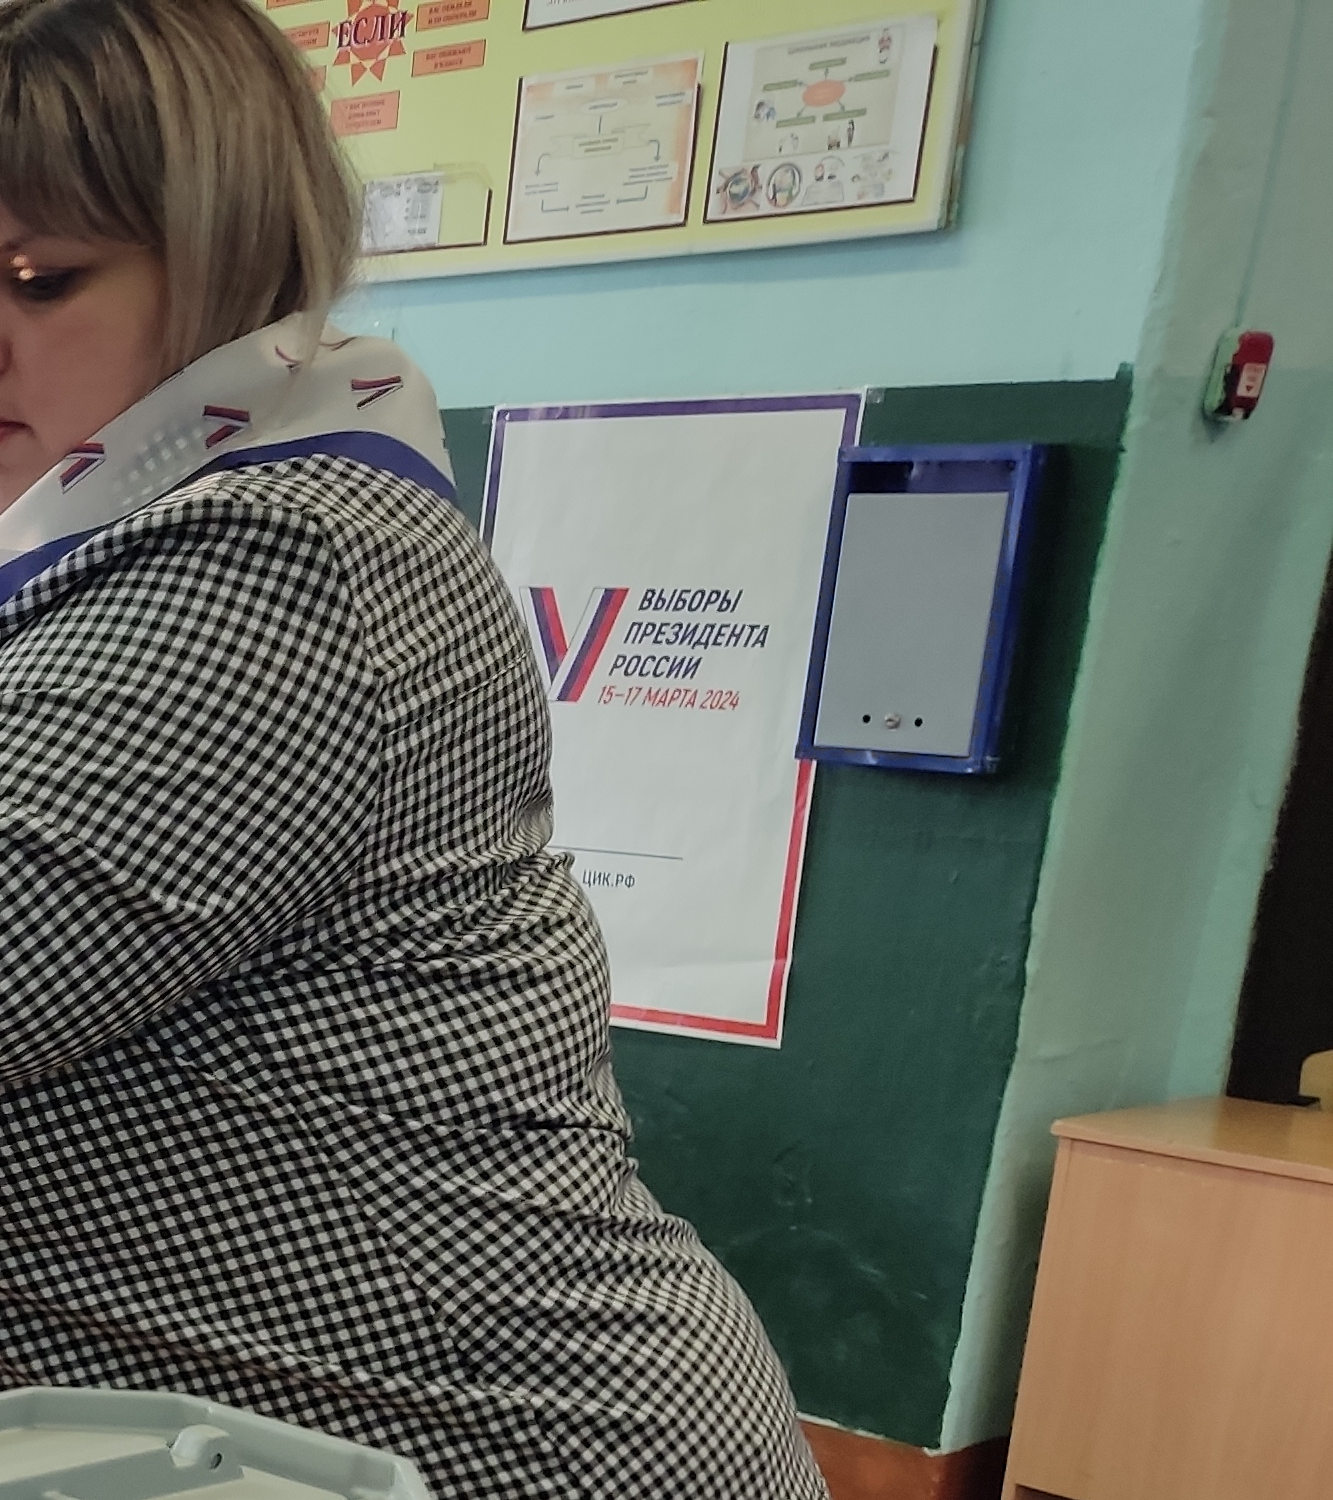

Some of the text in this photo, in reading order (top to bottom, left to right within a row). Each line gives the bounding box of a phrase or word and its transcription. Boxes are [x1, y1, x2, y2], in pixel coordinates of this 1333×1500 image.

[336, 10, 408, 49] ЕСЛИ
[637, 588, 743, 613] ВЫБОРЫ
[623, 621, 770, 650] ПРЕЗИДЕНТА
[608, 654, 703, 680] РОССИИ
[642, 687, 699, 710] МАРТА
[699, 689, 740, 711] 2024
[582, 868, 637, 890] ЦИК.РФ
